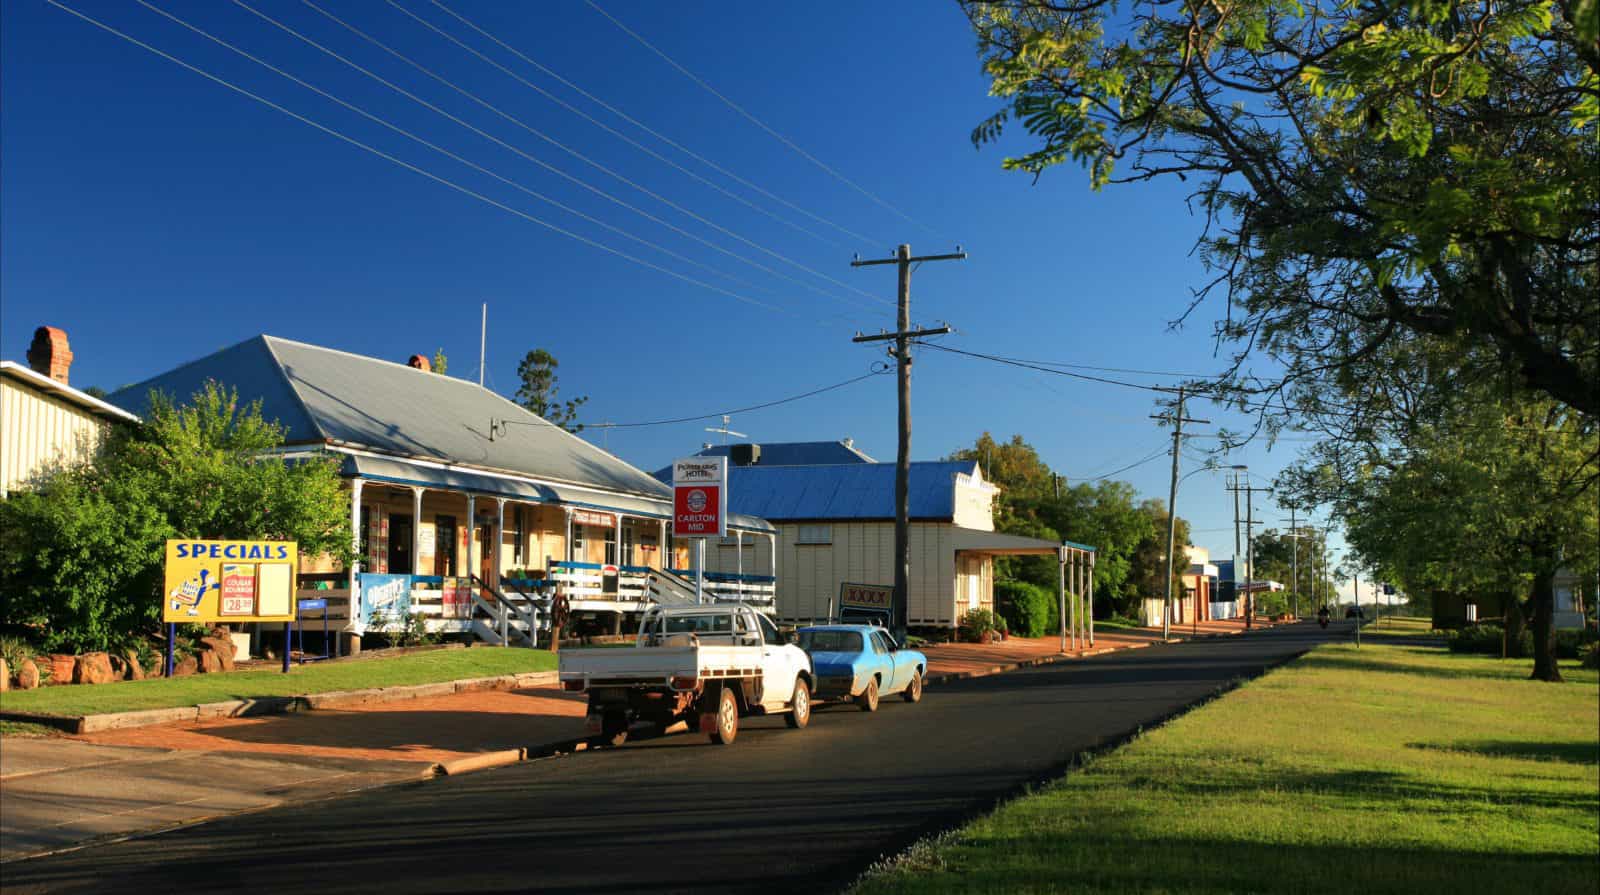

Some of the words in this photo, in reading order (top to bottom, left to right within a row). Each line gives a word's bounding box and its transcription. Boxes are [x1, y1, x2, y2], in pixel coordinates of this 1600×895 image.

[678, 514, 715, 522] CARLTON
[688, 523, 704, 531] MID
[176, 543, 288, 559] SPECIALS
[847, 588, 887, 605] XXXX
